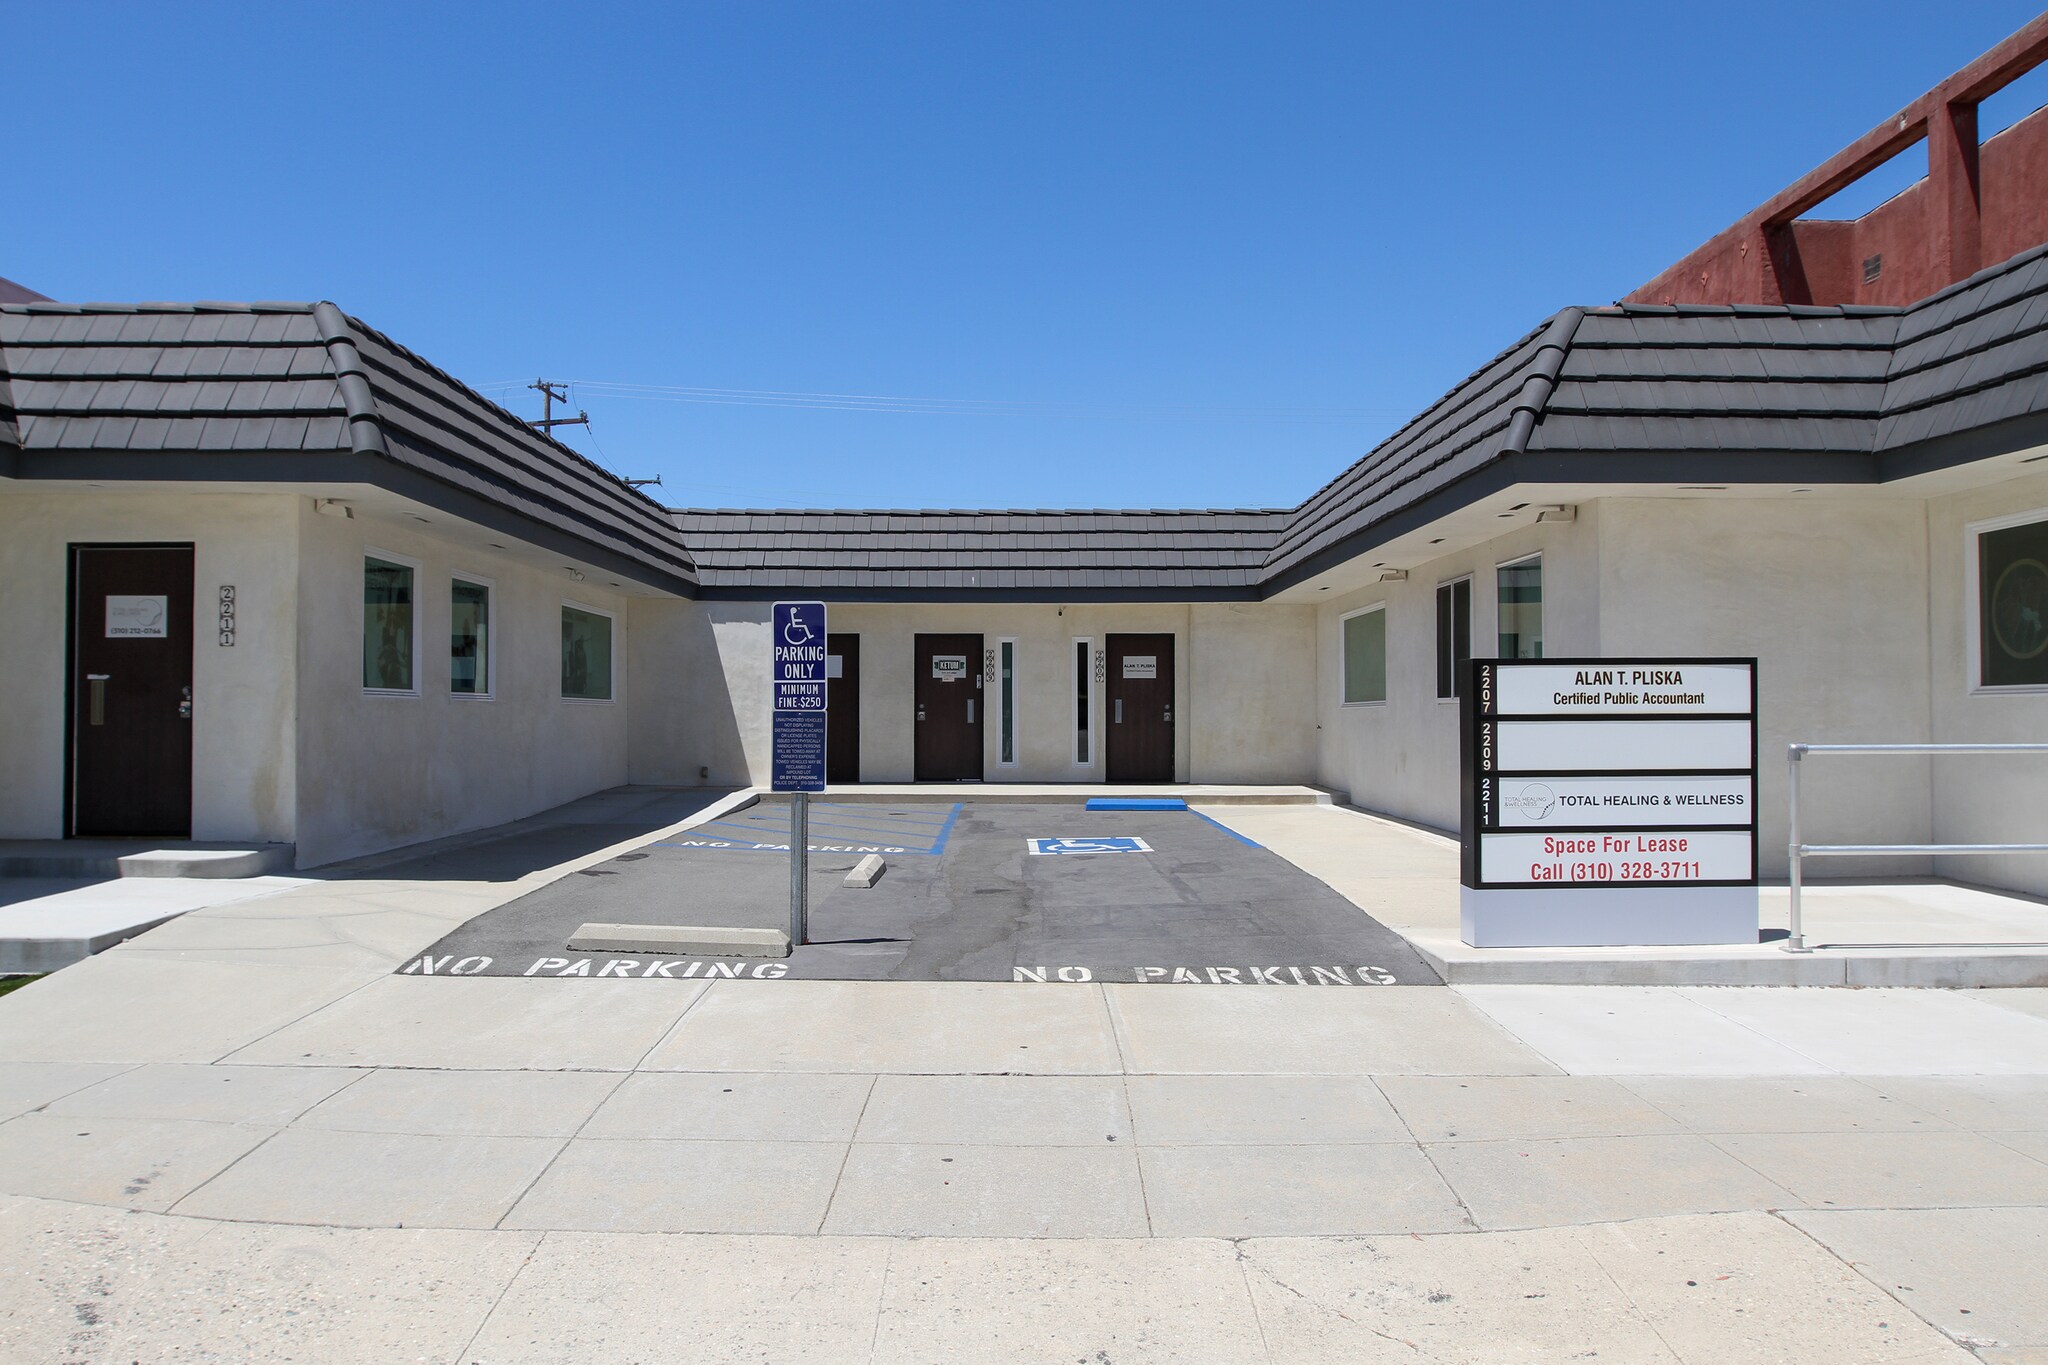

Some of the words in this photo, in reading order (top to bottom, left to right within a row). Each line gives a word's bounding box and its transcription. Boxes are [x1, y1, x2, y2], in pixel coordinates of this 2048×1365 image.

[222, 588, 232, 645] 2211
[776, 646, 823, 662] PARKING
[785, 664, 814, 679] ONLY
[1575, 671, 1613, 685] ALAN
[1618, 671, 1628, 685] T.
[1633, 671, 1683, 685] PLISKA
[782, 684, 818, 695] MINIMUM
[779, 698, 798, 707] FINE
[1554, 692, 1601, 705] Certified
[1604, 692, 1639, 704] Public
[1642, 692, 1704, 704] Accountant
[1559, 796, 1600, 806] TOTAL
[1604, 796, 1659, 806] HEALING
[1663, 796, 1671, 805] &
[1675, 795, 1744, 805] WELLNESS
[1544, 837, 1596, 857] Space
[1603, 837, 1630, 853] For
[1637, 836, 1688, 852] Lease
[1531, 864, 1563, 880] Call
[1570, 863, 1613, 882] (310)
[1621, 862, 1700, 879] 328-3711
[406, 955, 493, 975] NO
[522, 957, 790, 978] PARKING
[1013, 966, 1093, 982] NO
[1135, 966, 1396, 986] PARKING
